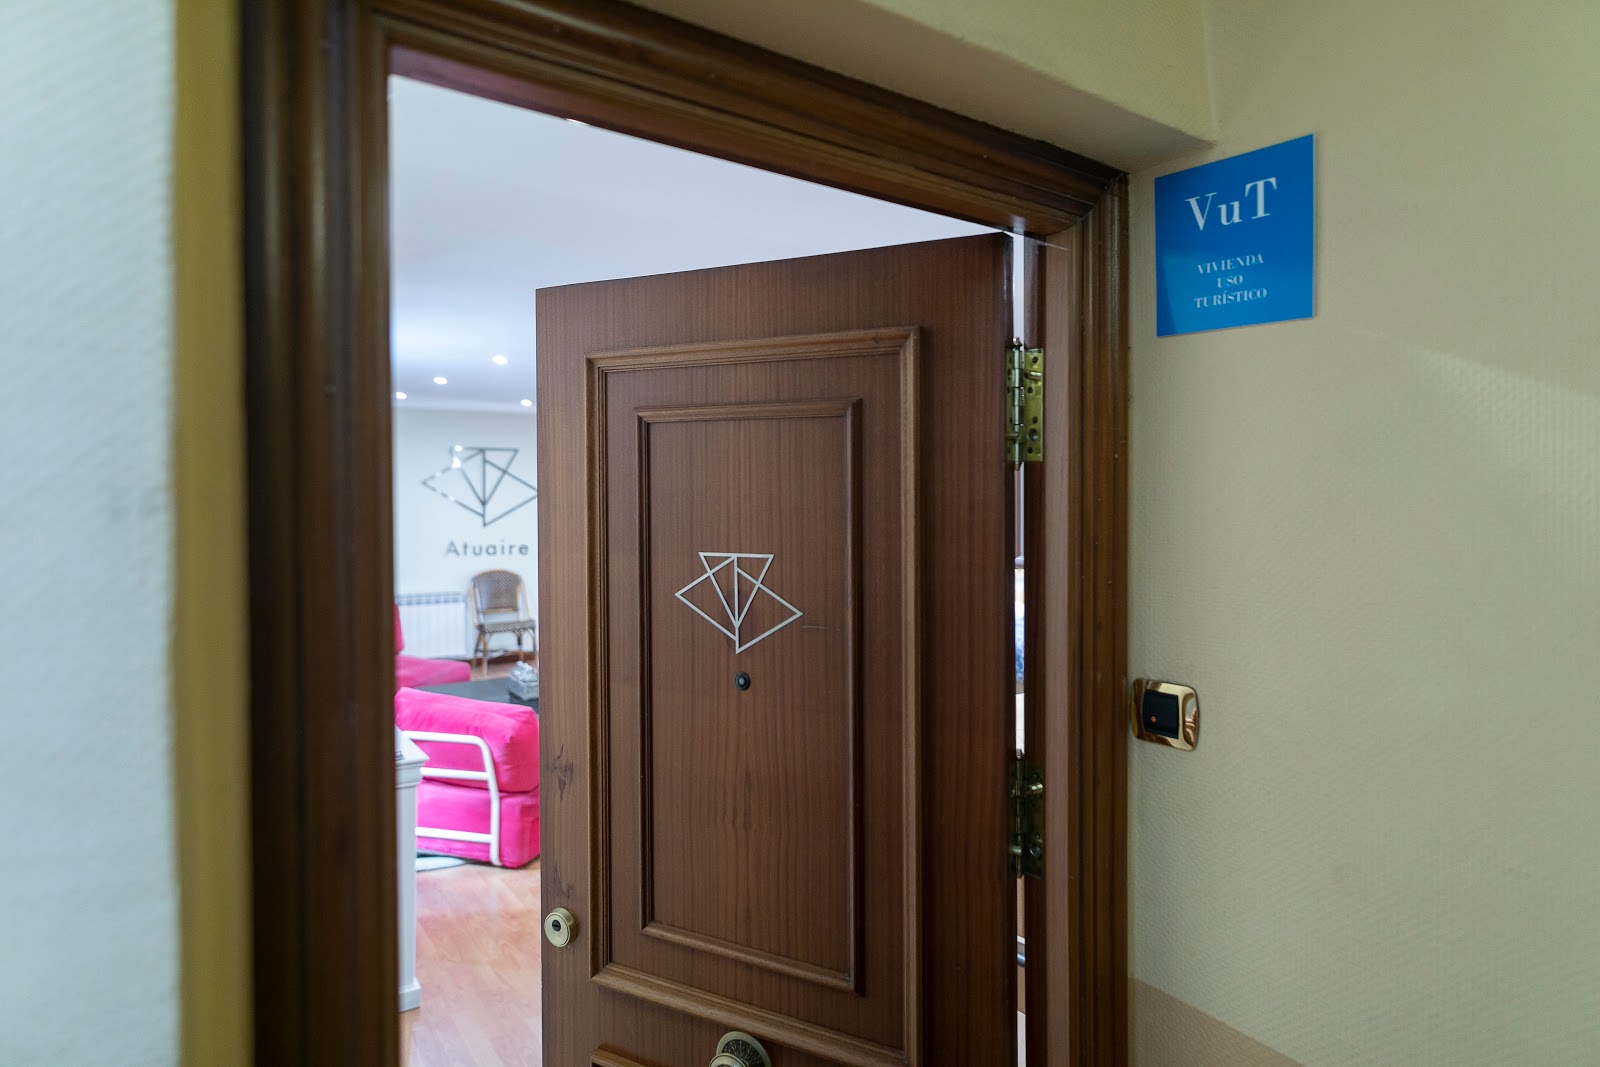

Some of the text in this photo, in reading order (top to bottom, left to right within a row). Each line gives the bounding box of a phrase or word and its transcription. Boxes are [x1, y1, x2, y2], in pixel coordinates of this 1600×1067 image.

[1185, 177, 1277, 231] VuT
[1197, 253, 1264, 274] VIVIENDA
[1217, 274, 1244, 288] USO
[1194, 288, 1268, 308] TURÍSTICO
[445, 539, 529, 556] Atuaire
